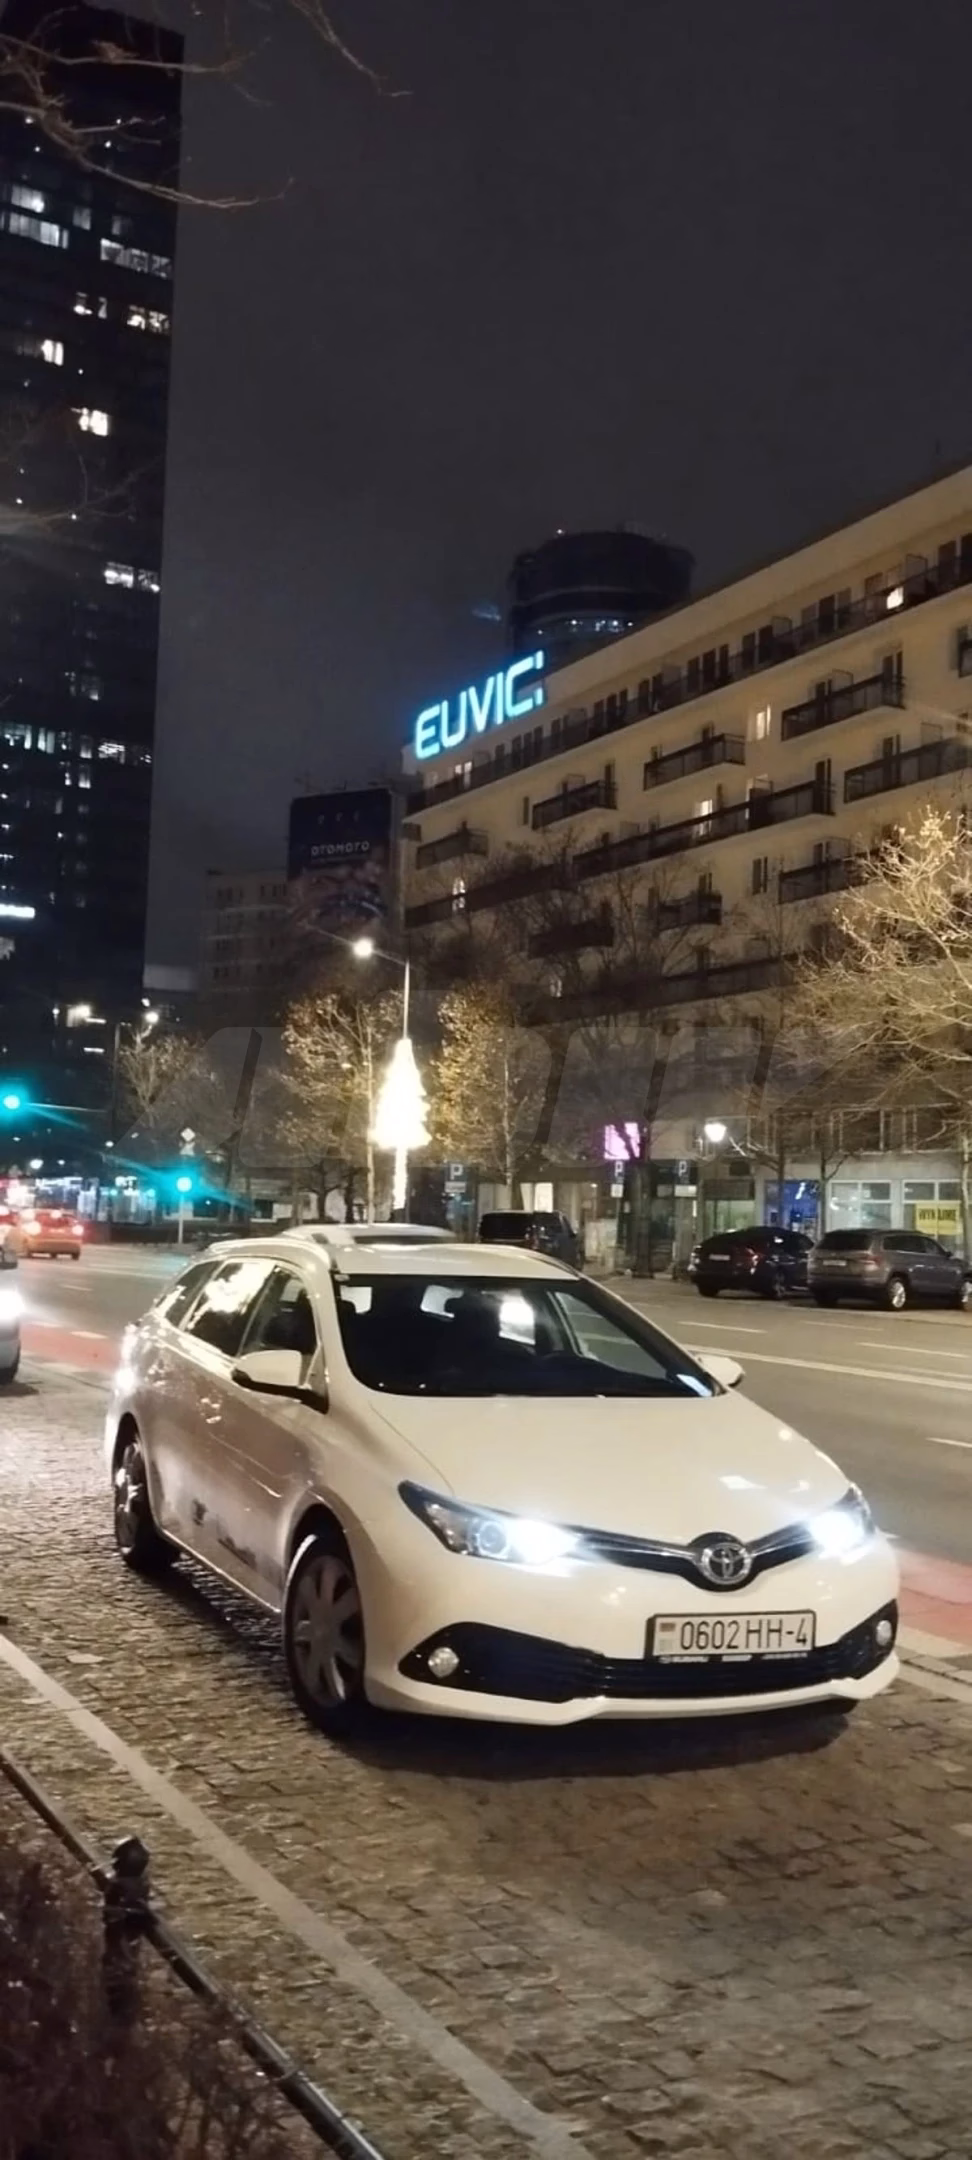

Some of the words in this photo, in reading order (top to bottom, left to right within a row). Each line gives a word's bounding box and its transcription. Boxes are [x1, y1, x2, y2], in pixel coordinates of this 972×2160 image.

[415, 650, 544, 760] EUVIC
[311, 840, 370, 856] OTOMOTO
[450, 1163, 464, 1180] P
[680, 1619, 740, 1650] 0602
[745, 1617, 808, 1649] HH-4
